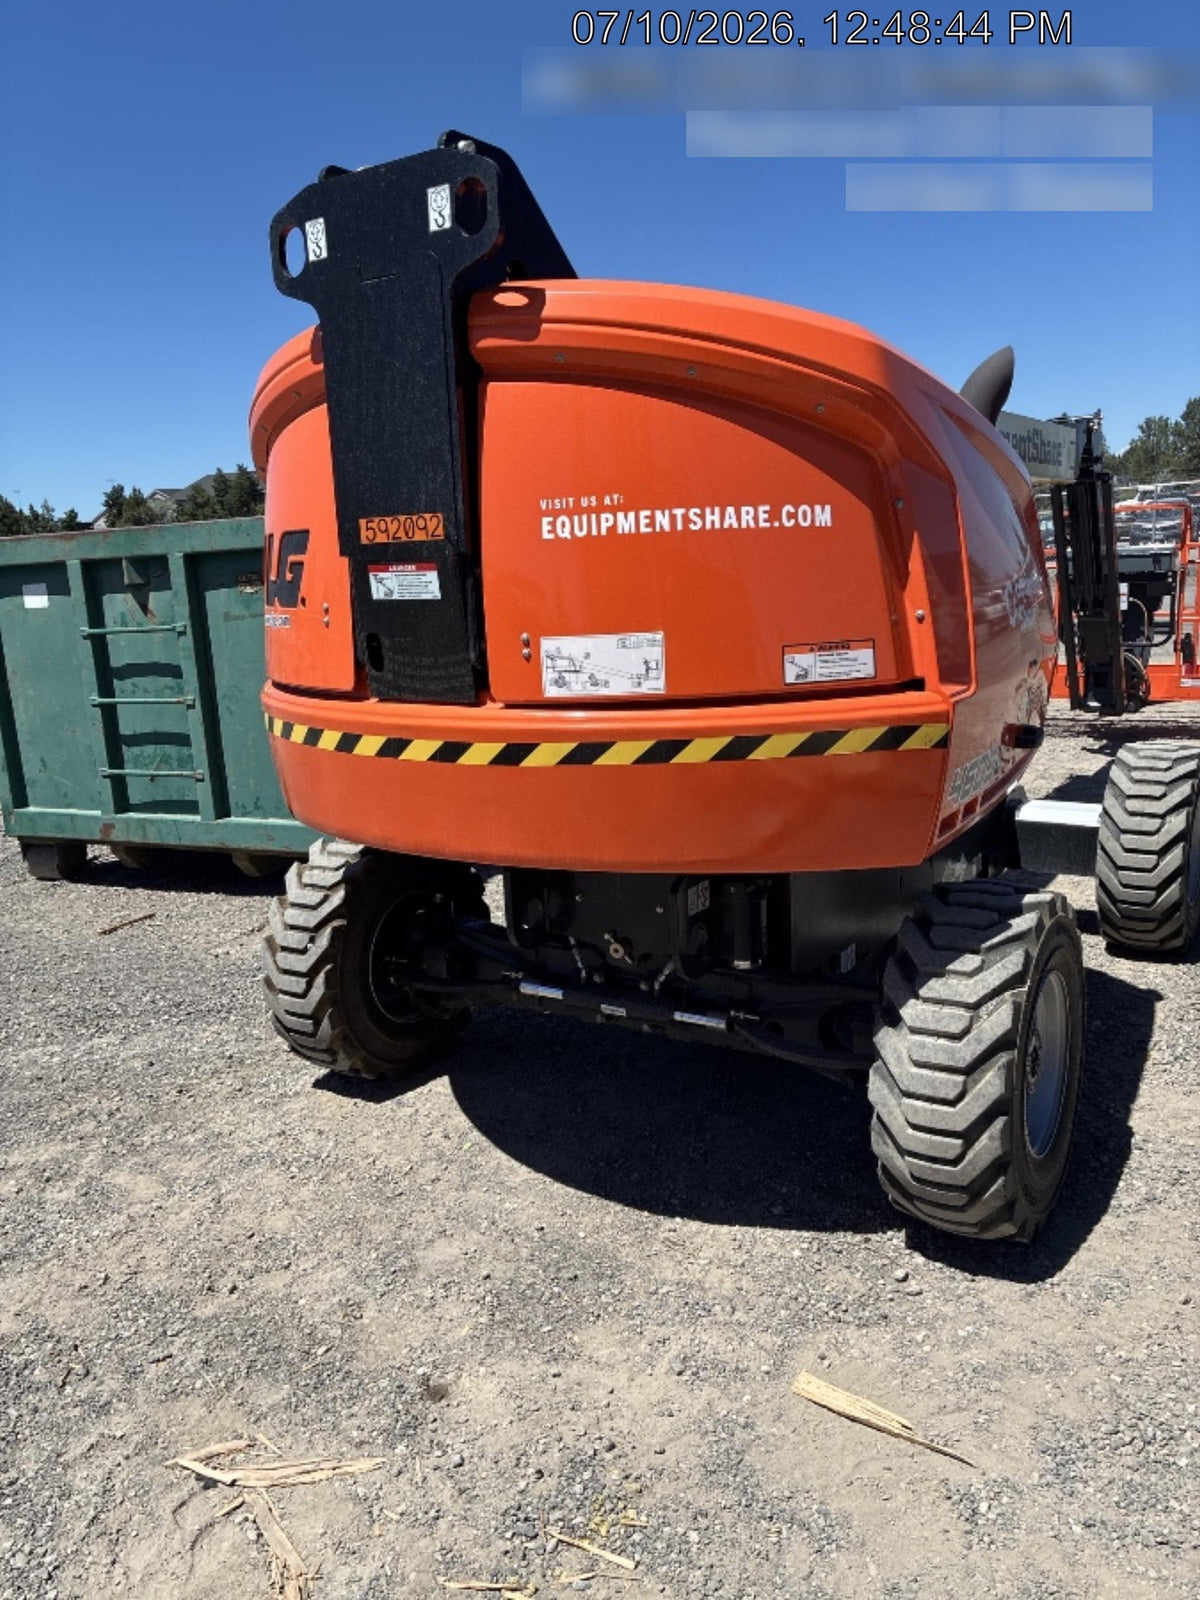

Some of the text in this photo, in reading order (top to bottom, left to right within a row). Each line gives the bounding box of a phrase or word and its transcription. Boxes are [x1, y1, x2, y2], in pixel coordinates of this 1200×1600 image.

[539, 493, 624, 511] VISIT US AT:
[365, 515, 443, 542] 592092
[541, 503, 834, 540] EQUIPMENTSHARE.COM
